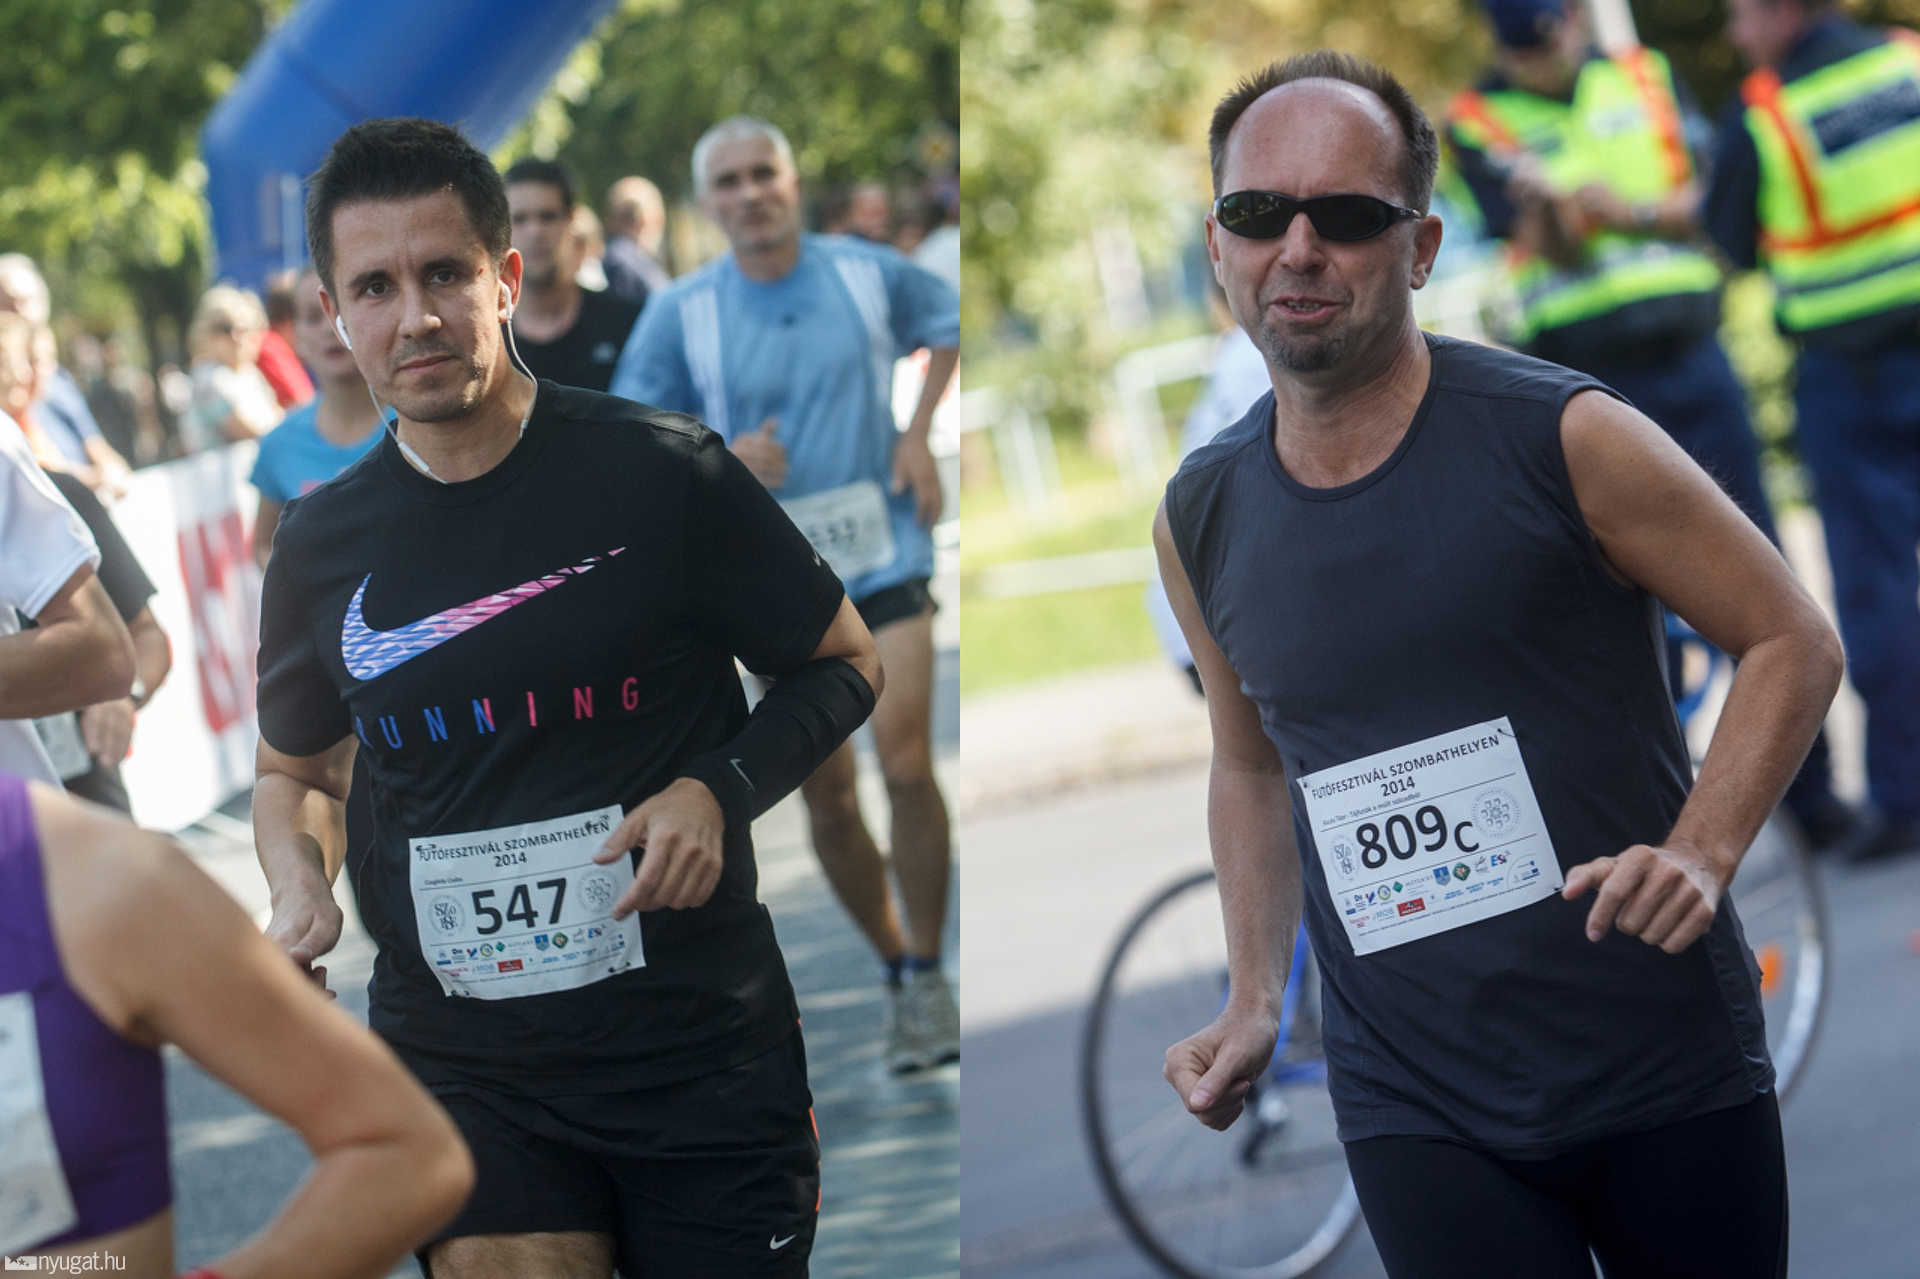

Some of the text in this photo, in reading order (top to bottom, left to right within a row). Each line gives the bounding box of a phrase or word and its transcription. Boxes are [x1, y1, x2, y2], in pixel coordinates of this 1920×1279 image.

[1389, 734, 1500, 777] SZOMBATHELYEN
[1380, 775, 1416, 797] 2014
[494, 851, 528, 868] 2014
[471, 877, 567, 936] 547
